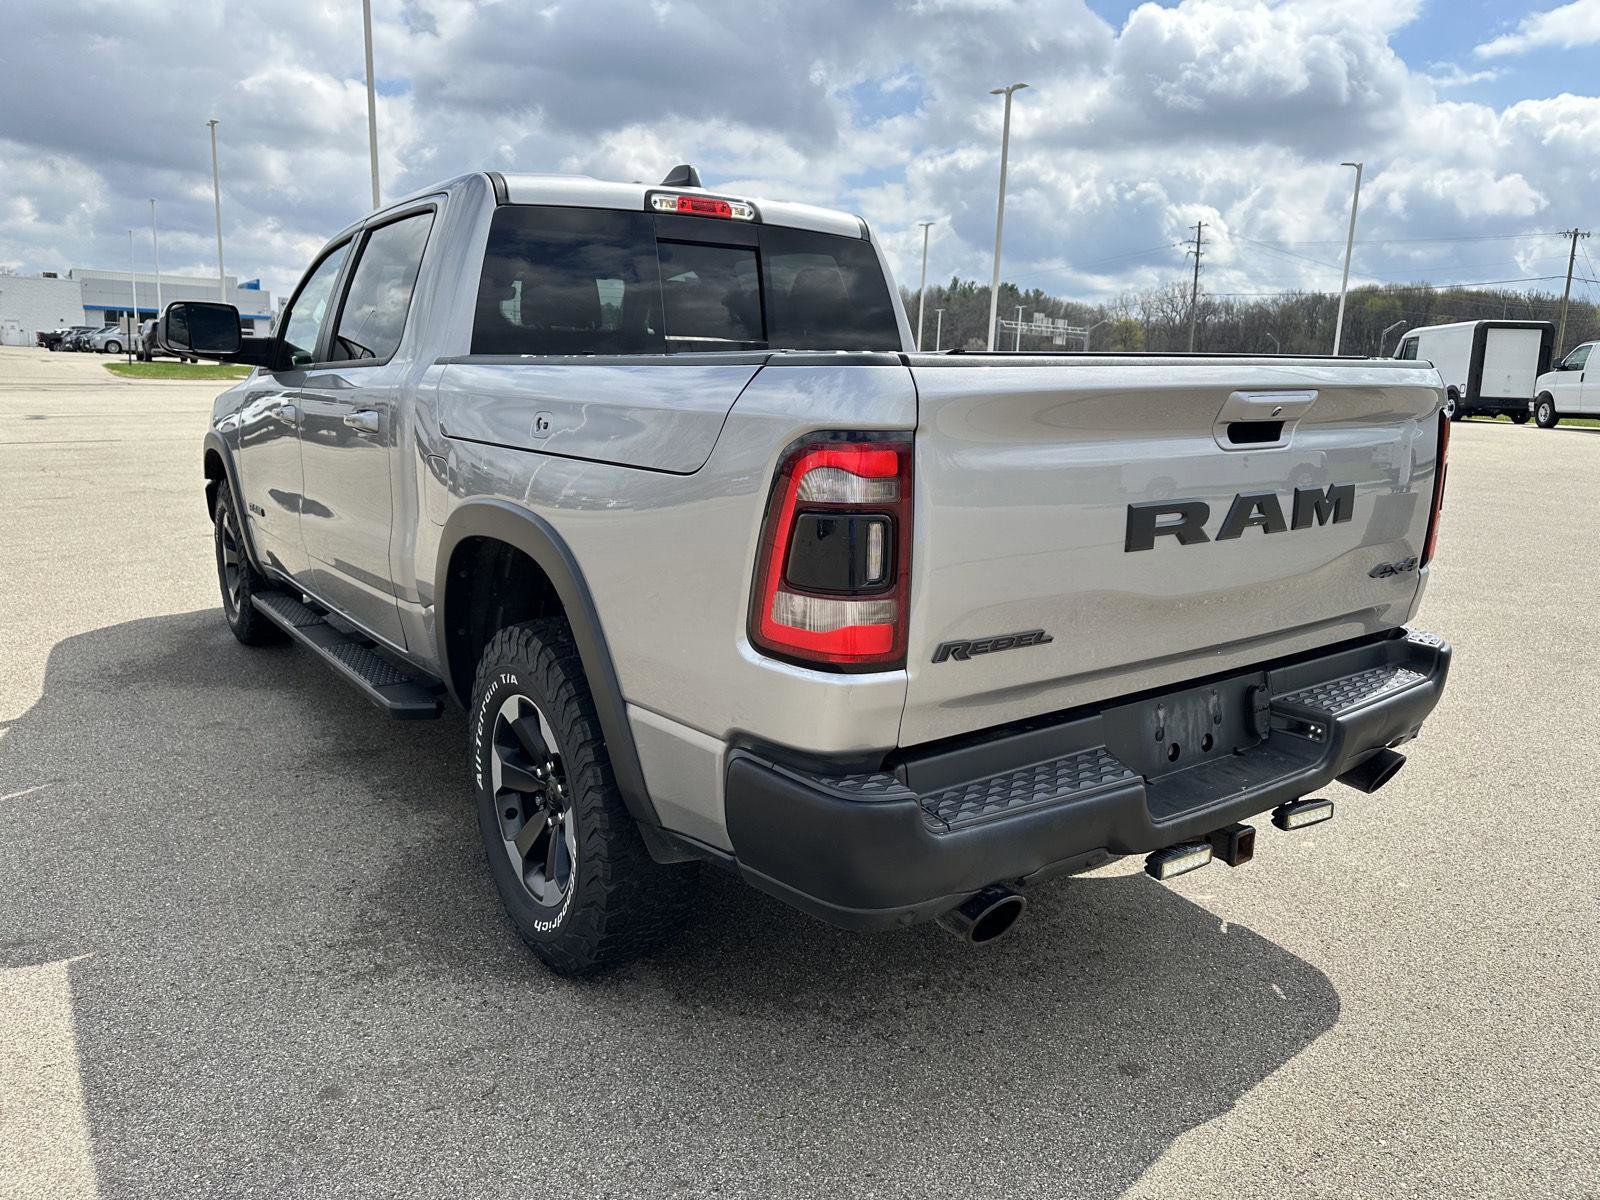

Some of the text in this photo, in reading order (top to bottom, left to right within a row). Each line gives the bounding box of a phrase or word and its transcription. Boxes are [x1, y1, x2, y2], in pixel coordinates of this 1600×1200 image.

[1125, 483, 1355, 552] RAM
[931, 629, 1054, 663] REBEL
[475, 673, 519, 791] All-Terrain T/A
